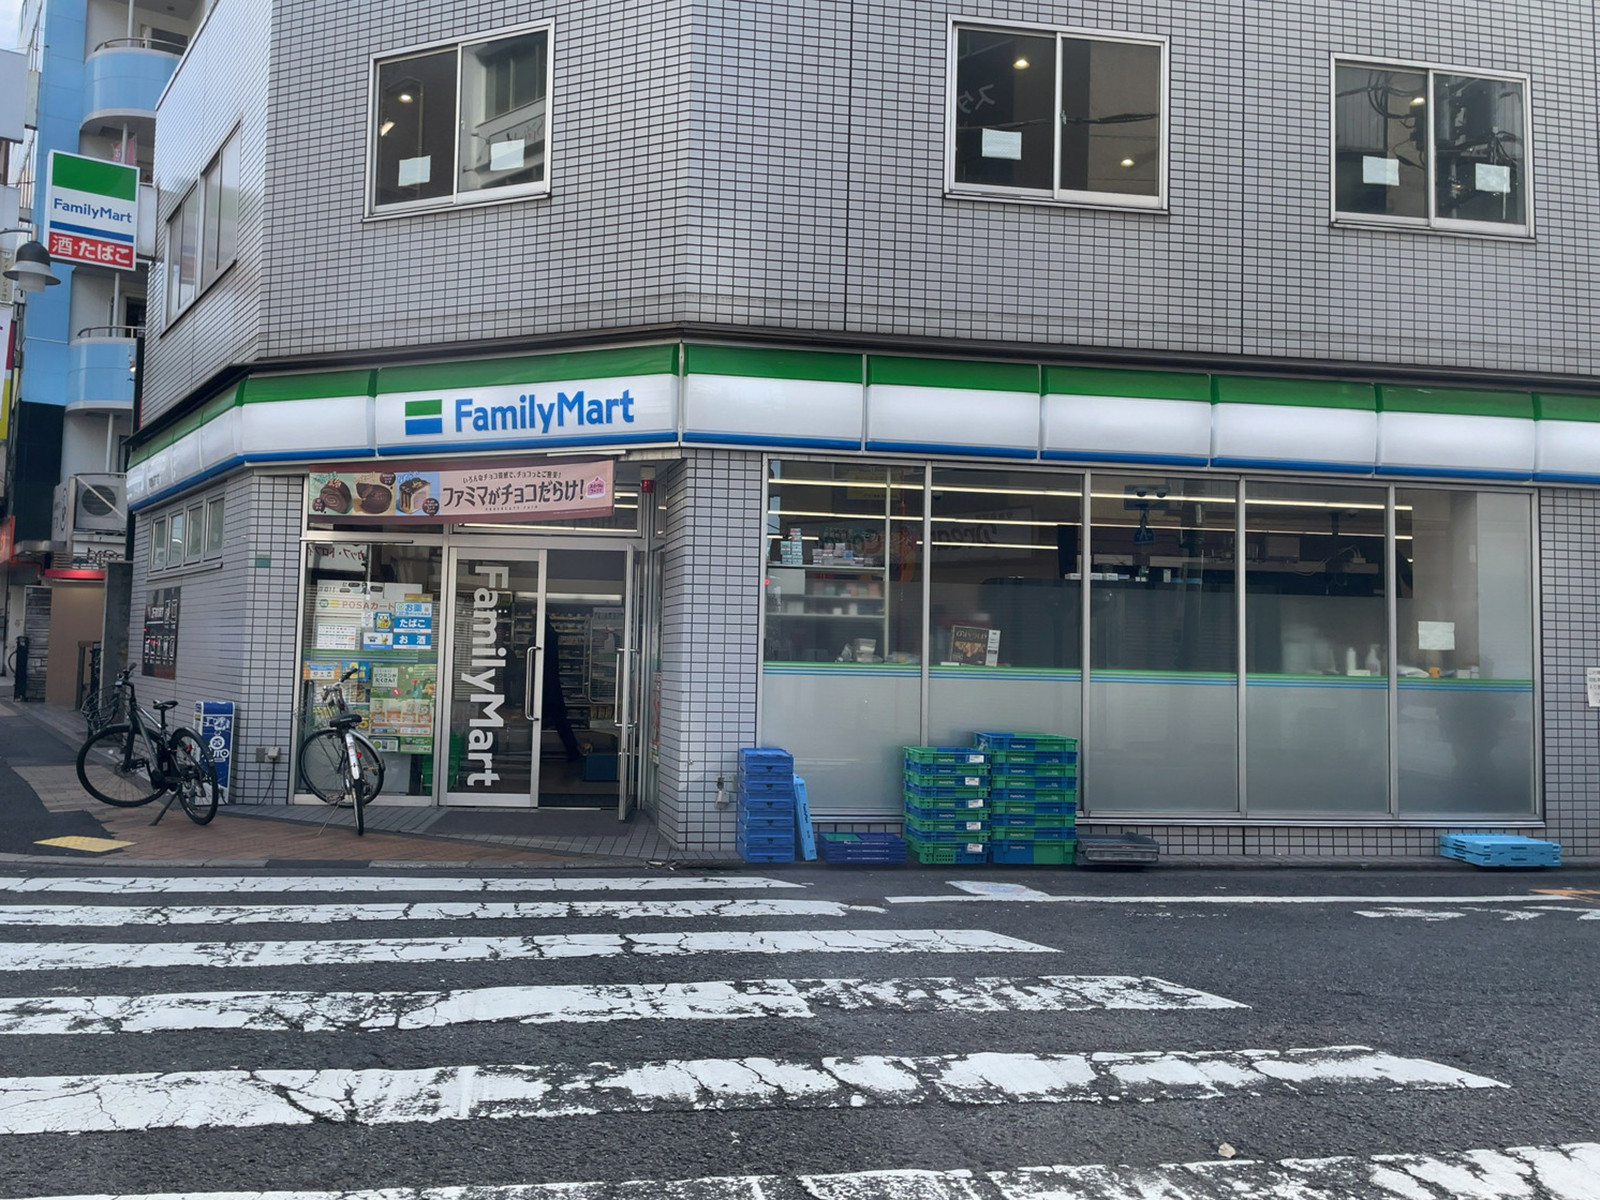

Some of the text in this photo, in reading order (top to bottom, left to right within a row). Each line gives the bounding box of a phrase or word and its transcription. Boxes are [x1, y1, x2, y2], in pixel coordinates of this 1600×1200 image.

[54, 197, 132, 223] FamilyMart
[52, 235, 130, 264] 酒・たばこ
[455, 389, 634, 434] FamilyMart
[399, 618, 426, 628] たばこ
[461, 565, 509, 787] FamilyMart
